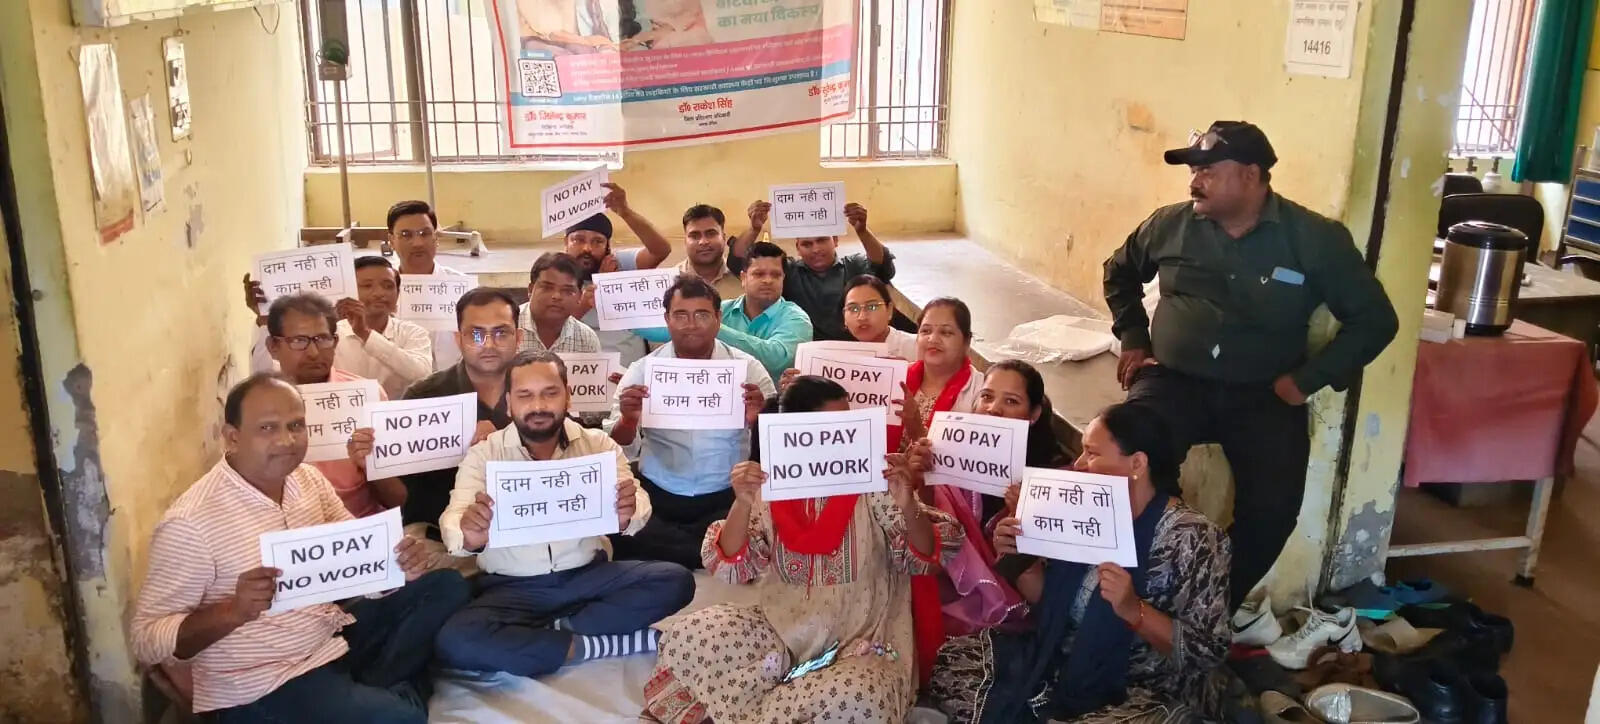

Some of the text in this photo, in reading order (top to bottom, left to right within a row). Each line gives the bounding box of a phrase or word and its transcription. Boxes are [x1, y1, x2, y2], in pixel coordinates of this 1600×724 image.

[717, 16, 737, 28] का
[740, 11, 769, 25] नया
[1304, 40, 1331, 54] 14416
[692, 99, 715, 111] राकेश
[717, 97, 733, 109] सिंह
[553, 179, 592, 203] NO PAY
[776, 189, 834, 204] दाम नही तो
[549, 196, 602, 224] NO WORK
[784, 207, 827, 222] काम नही
[263, 253, 338, 275] दाम नही तो
[274, 276, 333, 294] काम नही
[402, 282, 467, 295] दाम नही तो
[602, 276, 669, 294] दाम नही तो
[410, 303, 433, 313] काम
[612, 297, 664, 312] काम नही
[572, 364, 599, 375] PAY
[654, 369, 732, 385] दाम नही तो
[822, 365, 882, 382] NO PAY
[315, 392, 343, 411] नही
[348, 390, 365, 408] तो
[662, 392, 722, 408] काम नही
[331, 417, 358, 435] नही
[385, 410, 451, 431] NO PAY
[375, 434, 461, 459] NO WORK
[784, 428, 857, 448] NO PAY
[941, 427, 1001, 448] NO PAY
[773, 458, 870, 480] NO WORK
[932, 453, 1010, 479] NO WORK
[499, 466, 600, 493] दाम नही तो
[512, 493, 588, 517] काम नही
[1030, 484, 1111, 508] दाम नही तो
[1033, 515, 1101, 537] काम नही
[291, 534, 374, 565] NO PAY
[278, 560, 386, 593] NO WORK
